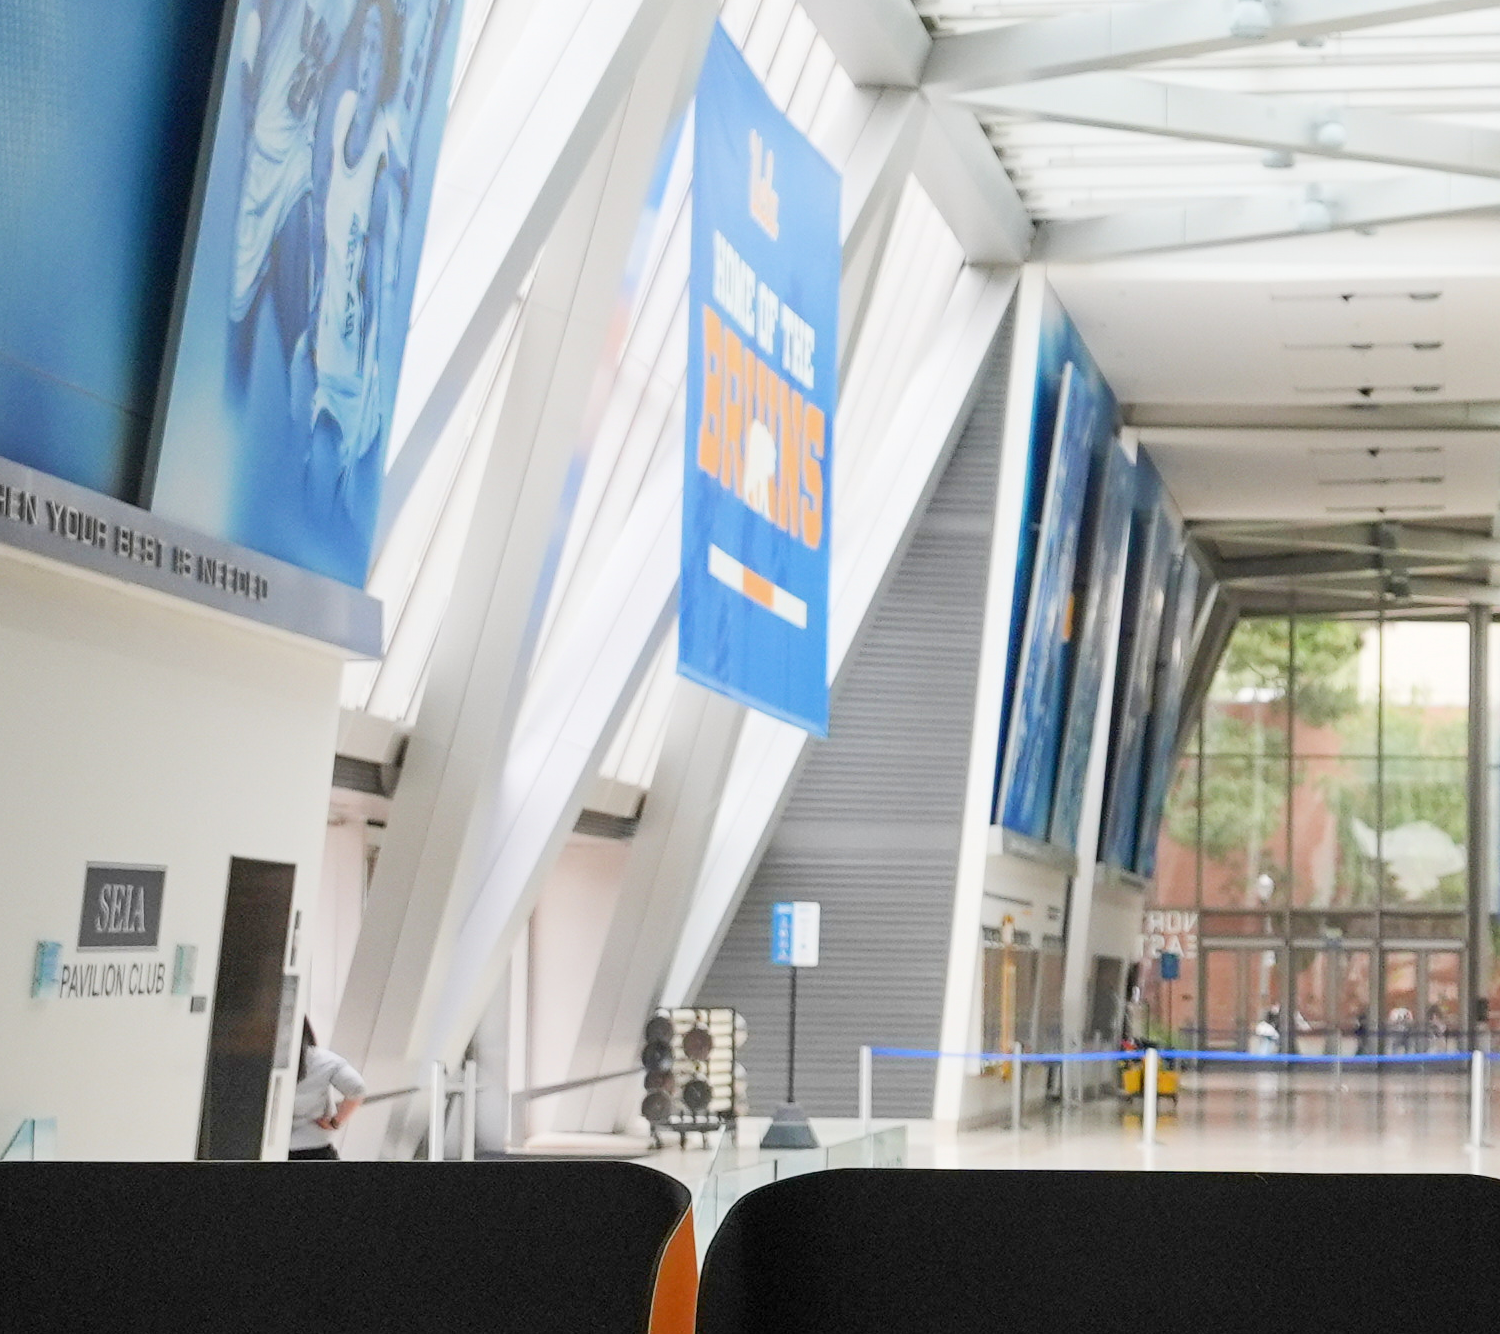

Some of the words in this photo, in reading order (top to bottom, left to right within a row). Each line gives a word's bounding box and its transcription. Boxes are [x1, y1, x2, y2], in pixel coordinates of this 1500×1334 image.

[712, 228, 757, 338] HOME
[756, 280, 780, 355] OF
[780, 301, 816, 390] THE
[49, 500, 108, 550] YOUR
[116, 526, 167, 570] BEST
[174, 547, 197, 580] IS
[94, 883, 146, 934] SEIA
[60, 963, 126, 999] PAVILION
[128, 962, 166, 997] CLUB
